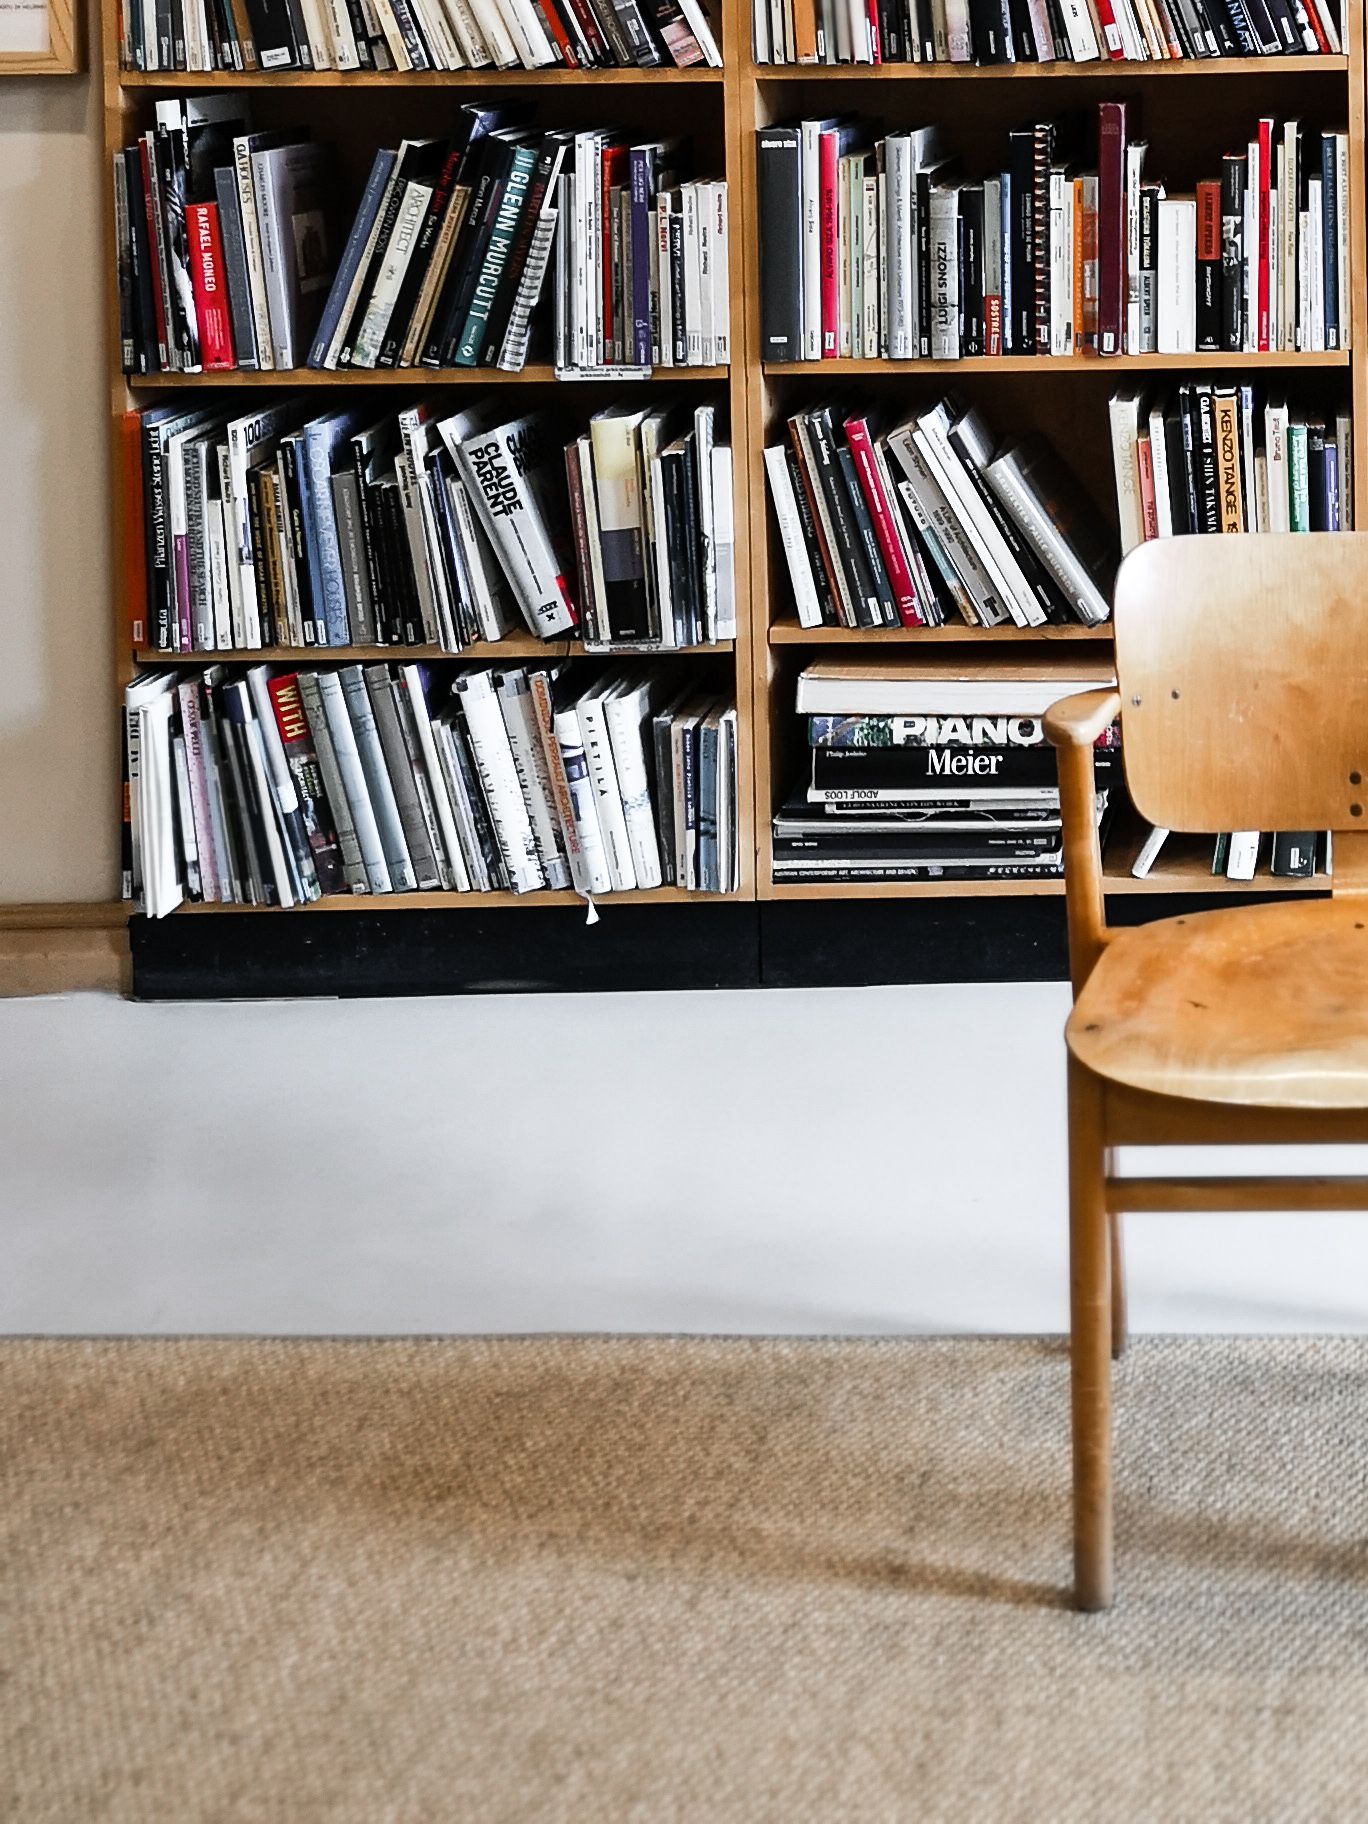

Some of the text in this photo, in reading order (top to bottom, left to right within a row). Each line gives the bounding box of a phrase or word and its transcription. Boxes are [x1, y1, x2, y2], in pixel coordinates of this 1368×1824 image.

[236, 144, 248, 160] GA
[196, 208, 216, 292] RAFAEL MONEO
[394, 188, 426, 256] ARCHITECT
[468, 170, 530, 322] GLENN MURCUTT
[936, 242, 948, 326] LUIGI SNOZZI
[468, 446, 508, 518] PARENT
[482, 442, 523, 516] CLAUDE
[1220, 409, 1236, 515] KENZO TANGE
[275, 684, 308, 739] WITH
[892, 717, 1043, 745] PIANO
[926, 749, 1003, 776] Meier
